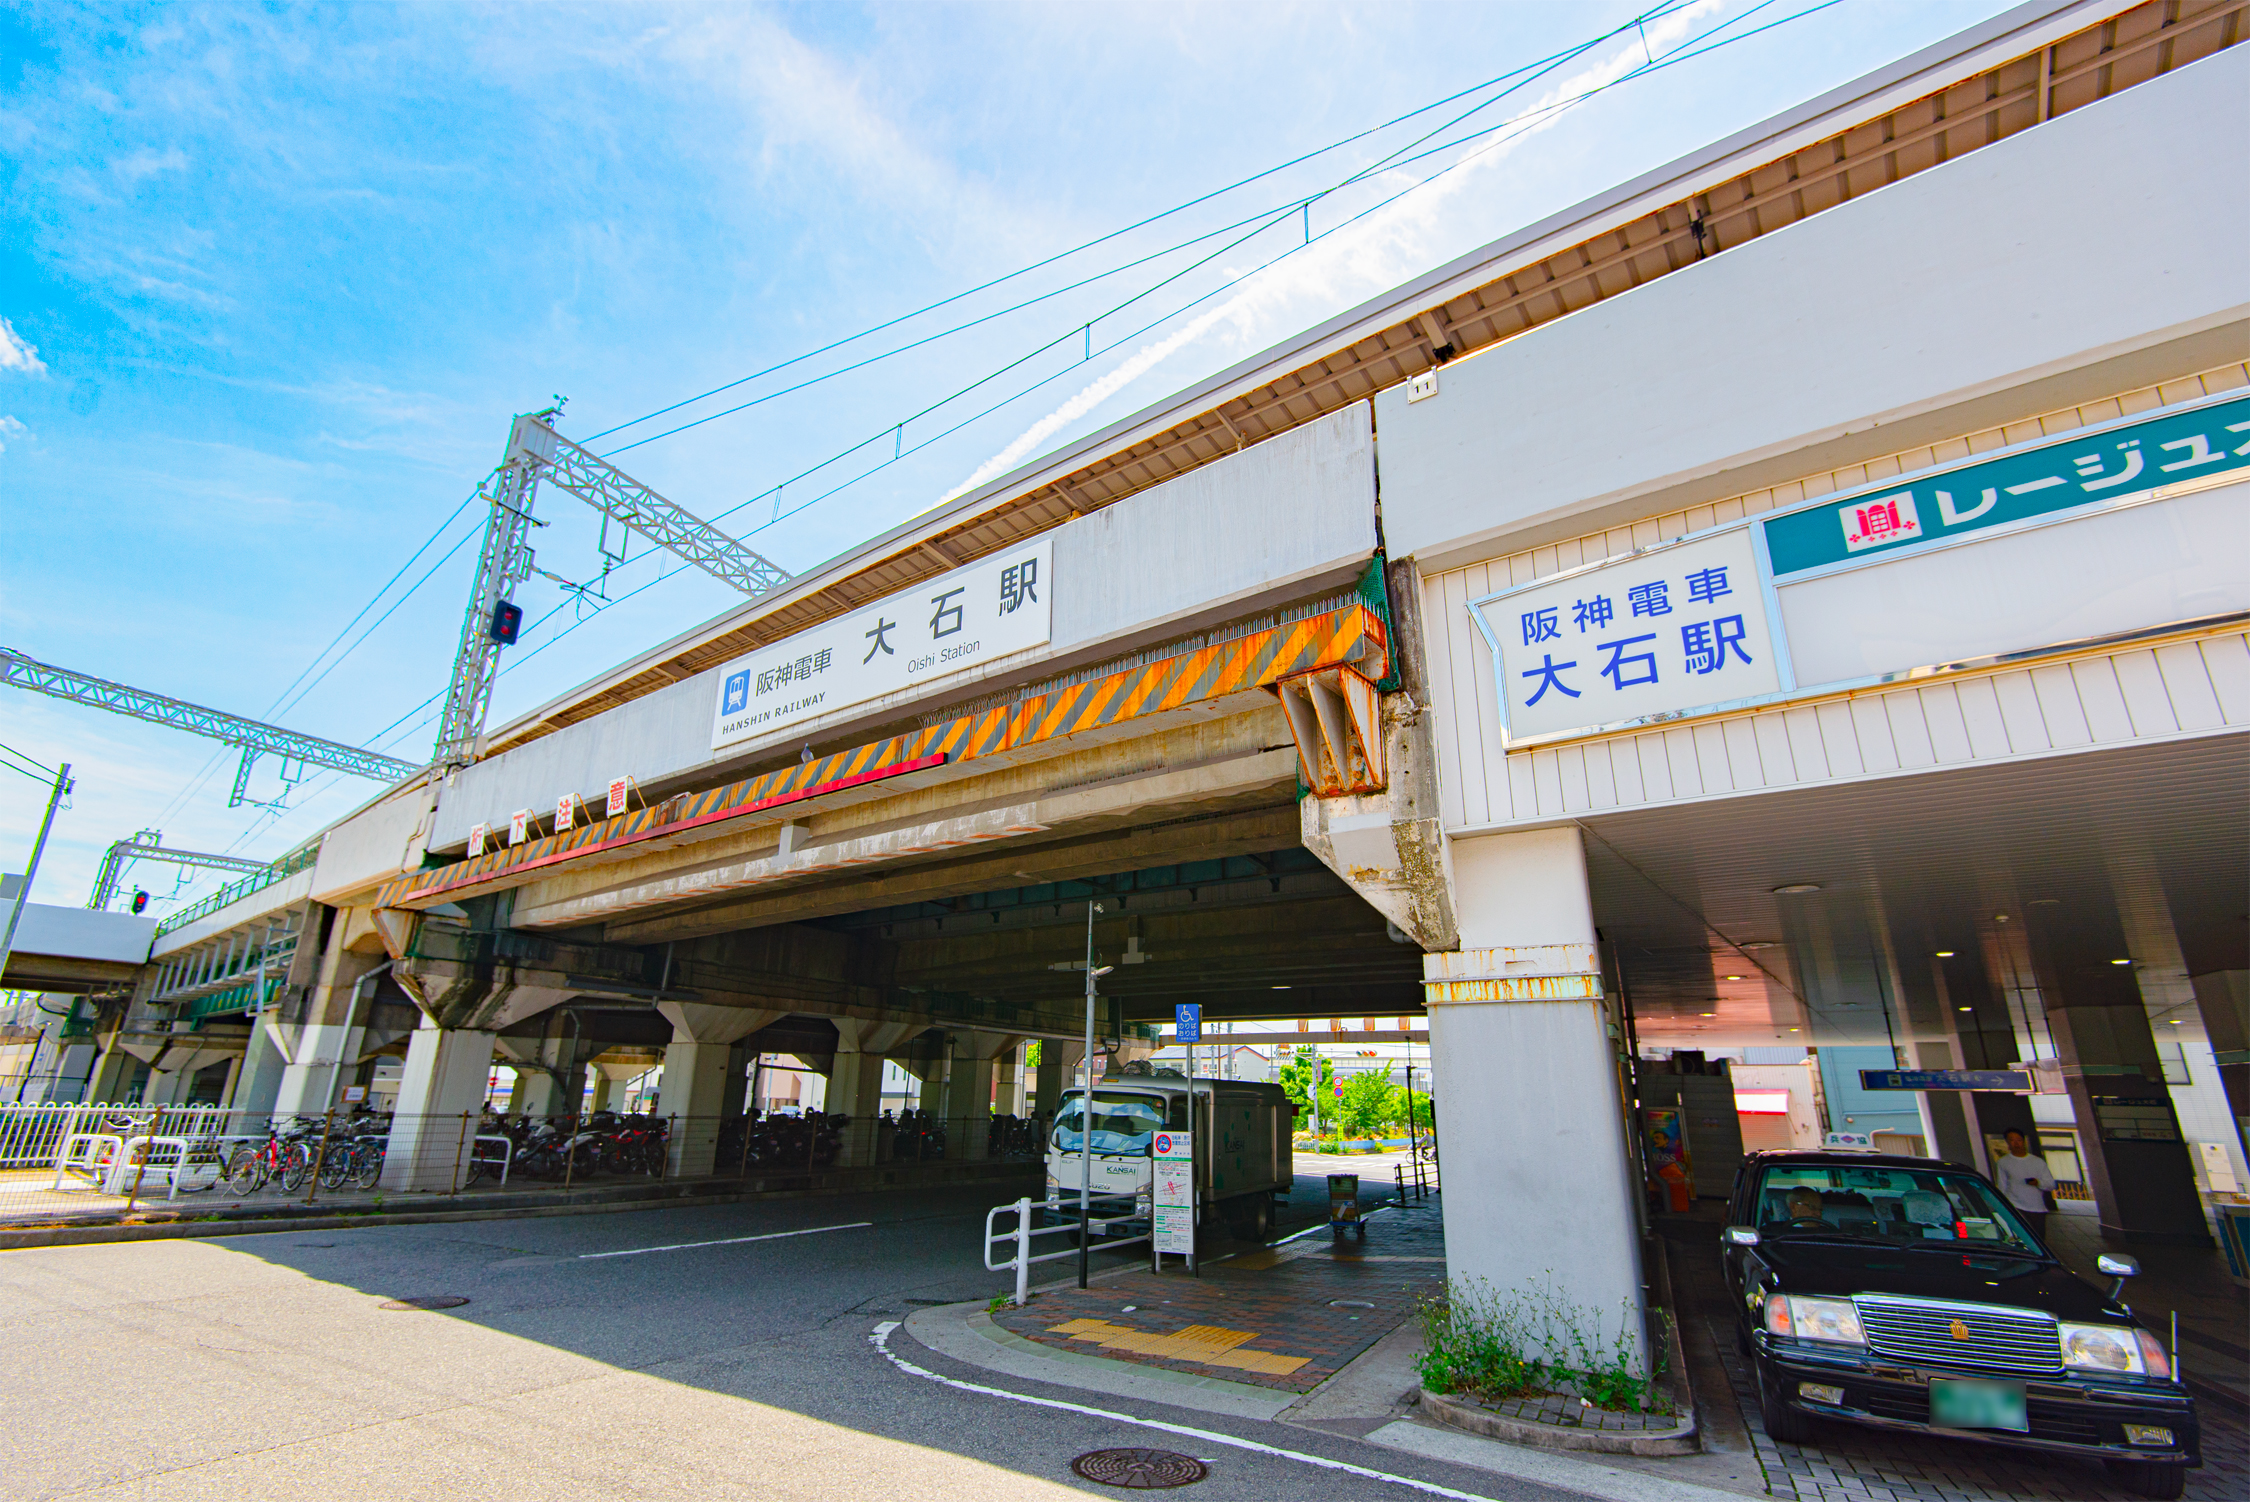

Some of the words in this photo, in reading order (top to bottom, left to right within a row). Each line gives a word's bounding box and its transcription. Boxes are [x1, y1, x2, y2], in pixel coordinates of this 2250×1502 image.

[1521, 566, 1733, 647] 阪神電車
[755, 647, 833, 697] 阪神電車
[862, 557, 1038, 666] 大石駅
[907, 652, 935, 673] Oishi
[940, 640, 980, 663] Station
[1522, 614, 1753, 708] 大石駅
[722, 710, 771, 735] HANSHIN
[774, 691, 826, 717] RAILWAY
[1177, 1022, 1197, 1030] のりば
[1177, 1029, 1197, 1037] おりば
[1106, 1165, 1136, 1176] KANSAI
